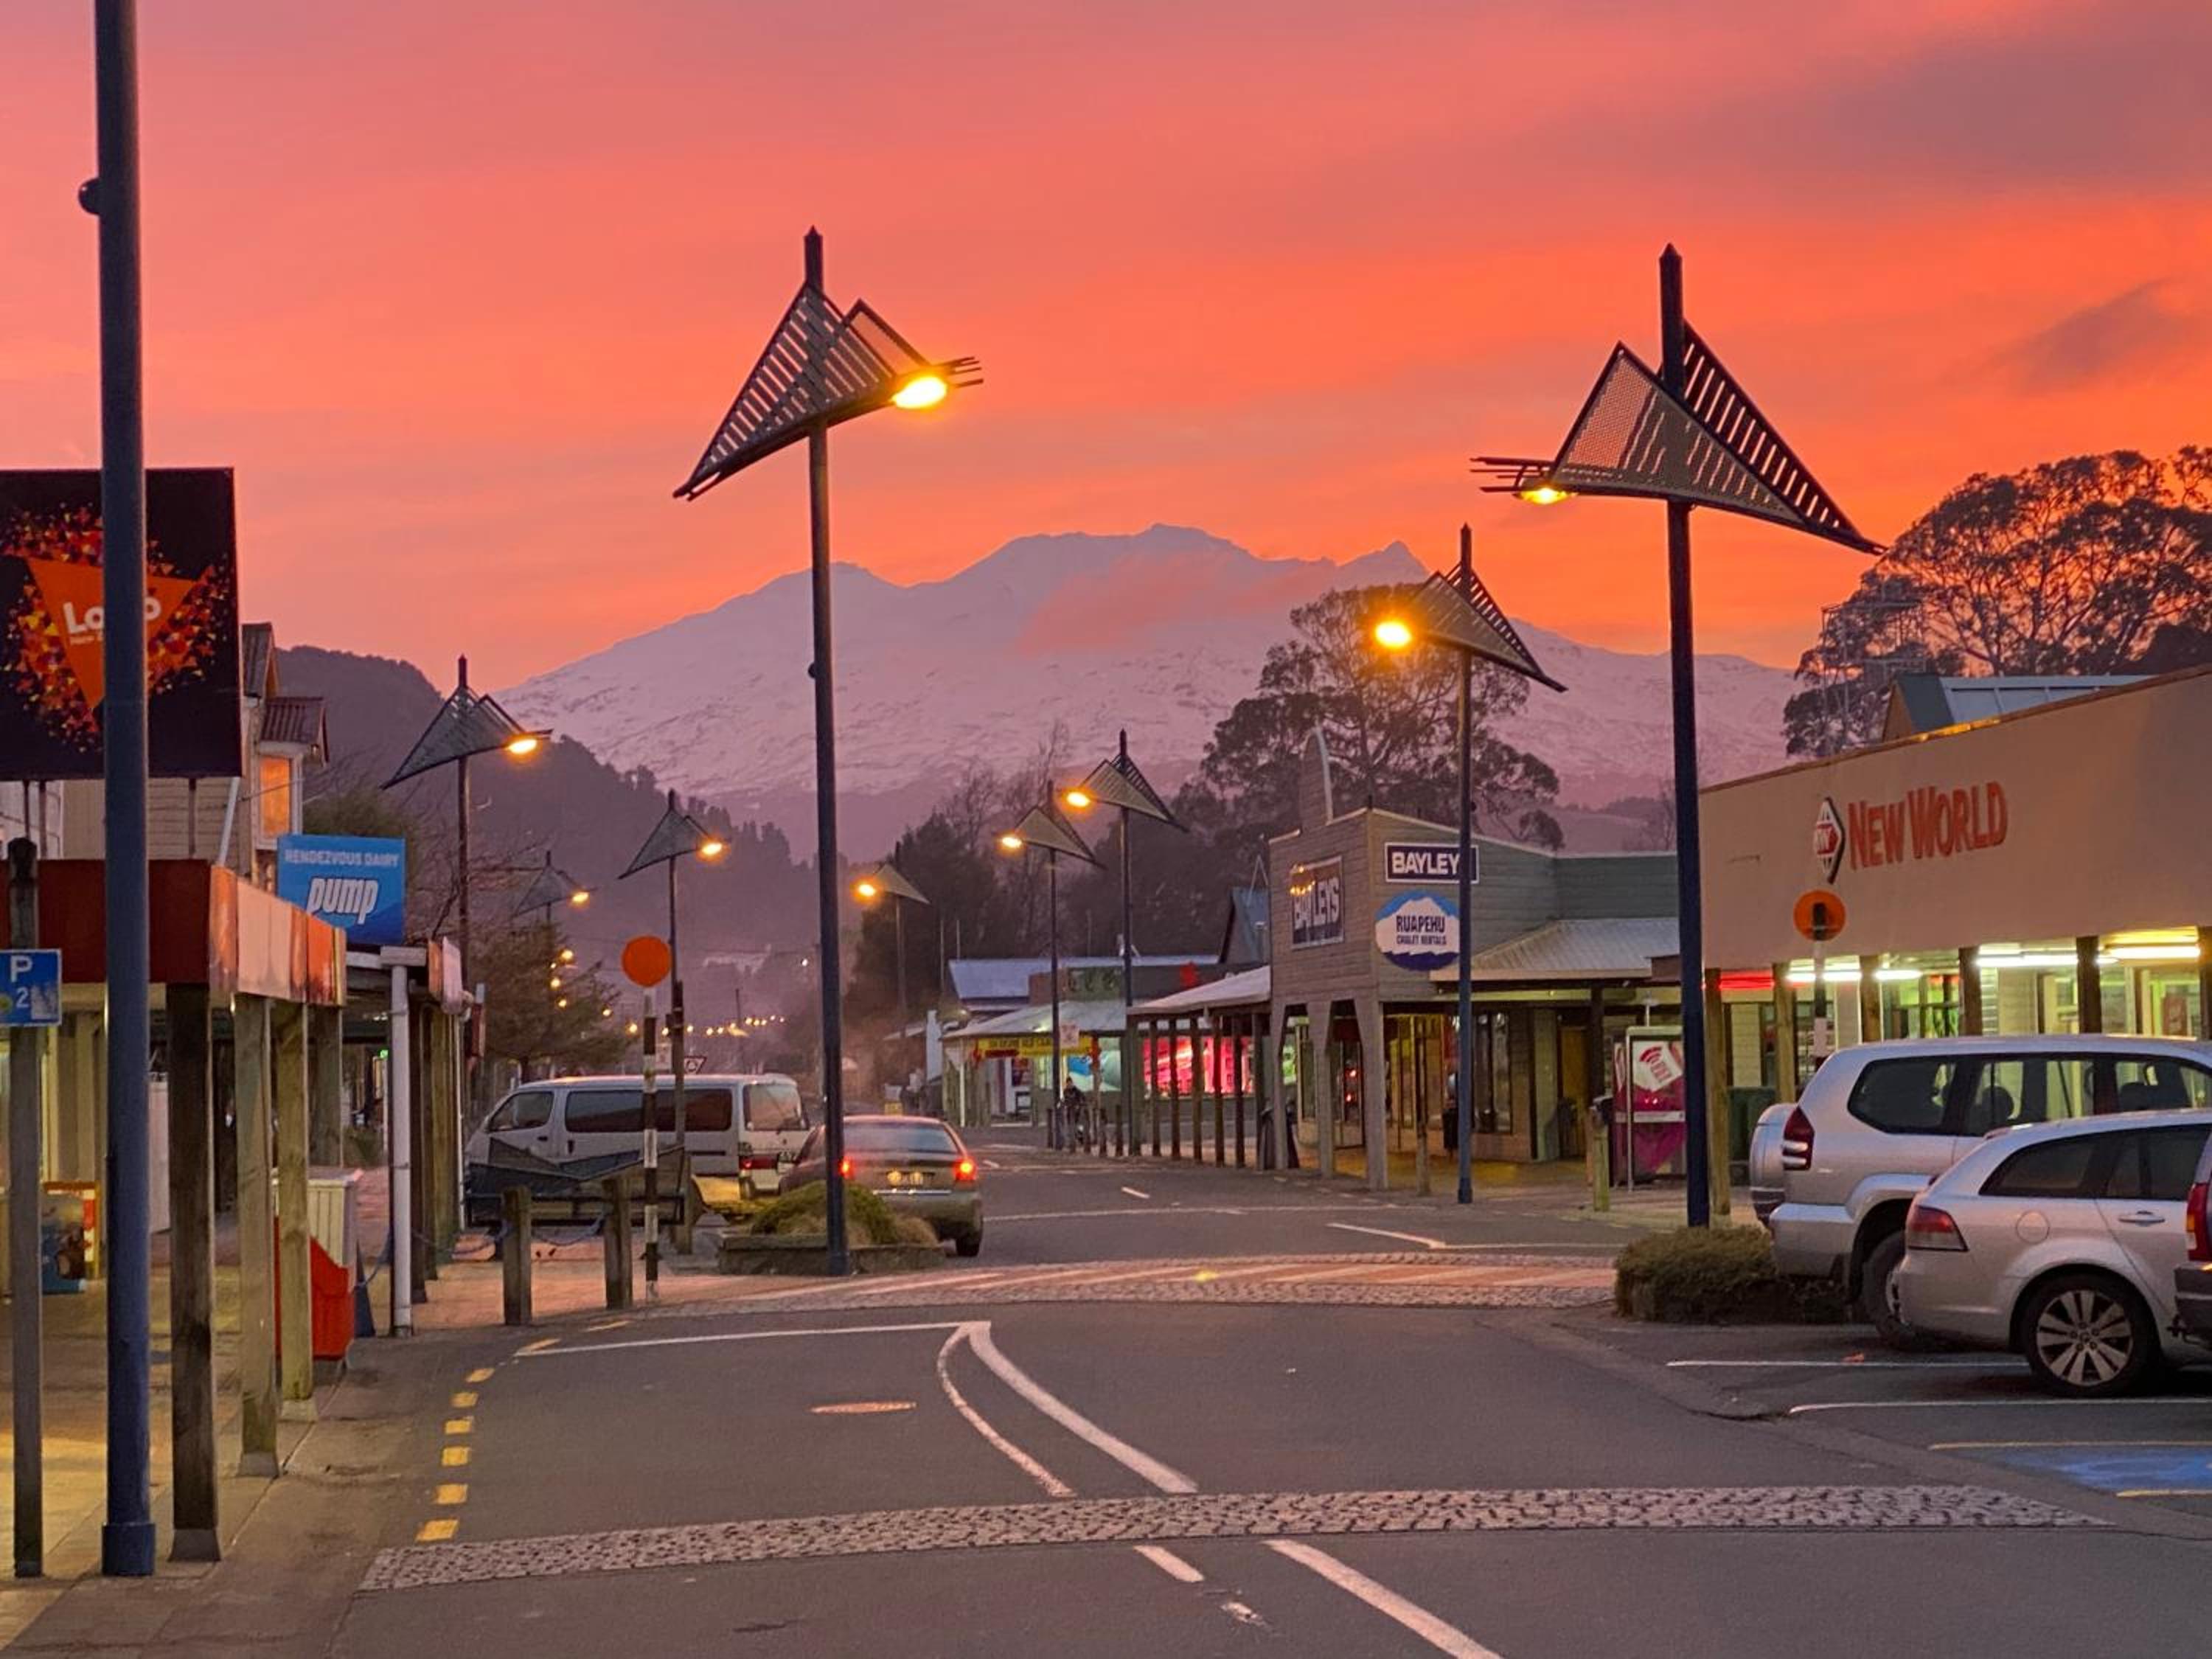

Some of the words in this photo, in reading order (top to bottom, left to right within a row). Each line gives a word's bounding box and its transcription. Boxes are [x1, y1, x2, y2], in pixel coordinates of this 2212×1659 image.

[1848, 801, 1906, 872] NEW
[1907, 782, 2008, 859] WORLD
[1391, 852, 1461, 875] BAYLEY
[1396, 916, 1446, 933] RUAPEHU
[10, 955, 32, 983] P
[15, 987, 29, 1009] 2
